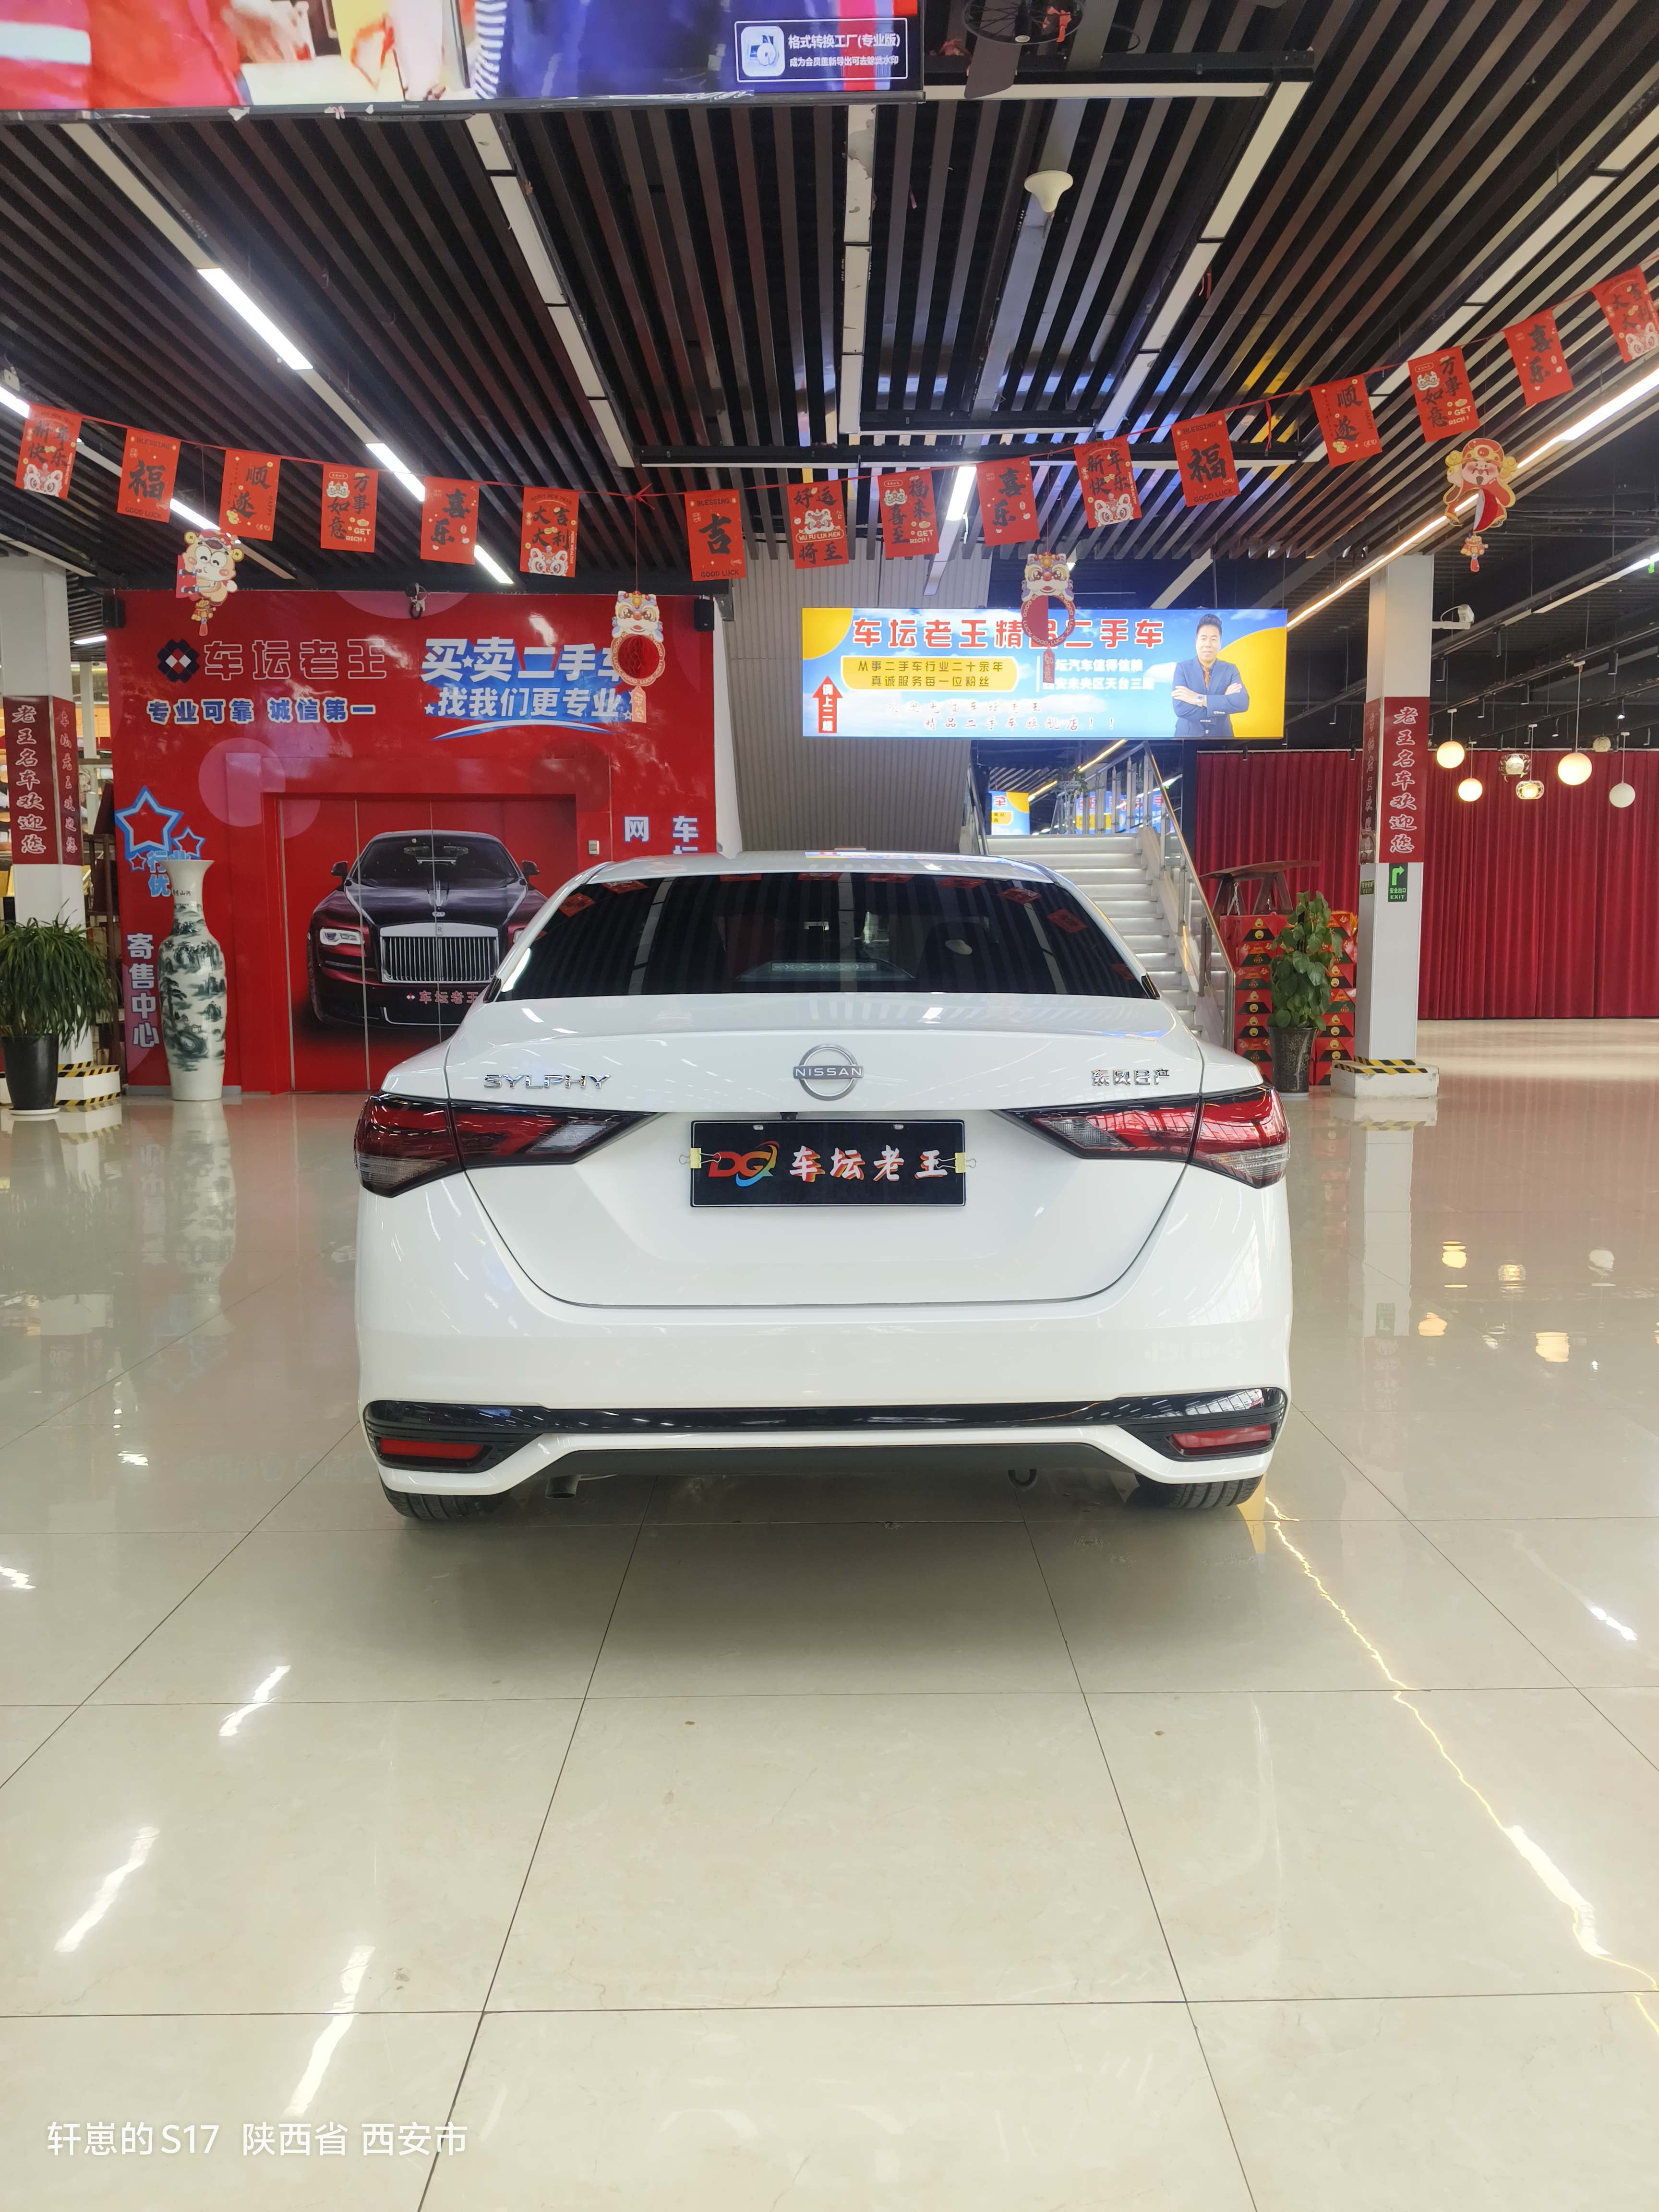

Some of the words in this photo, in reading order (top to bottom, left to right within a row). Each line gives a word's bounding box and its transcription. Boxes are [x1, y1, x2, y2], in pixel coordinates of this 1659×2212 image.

[1454, 406, 1471, 416] GET
[1182, 421, 1216, 434] BLESSING
[137, 437, 170, 449] BLESSING
[1087, 450, 1125, 475] 新年
[1187, 443, 1227, 483] 福
[128, 460, 166, 501] 福
[697, 498, 730, 506] BLESSING
[1194, 493, 1214, 502] GOOD
[1215, 488, 1233, 497] LUCK
[125, 507, 143, 515] GOOD
[145, 510, 162, 519] LUCK
[532, 505, 570, 526] 大吉
[532, 527, 570, 551] 大利
[698, 514, 732, 554] 吉
[204, 639, 386, 681] 车坛老王
[858, 661, 1004, 673] 从事二手车行业二十余年
[1055, 659, 1143, 672] 坛汽车值得信赖
[871, 676, 989, 687] 真诚服务每一位粉丝
[147, 698, 254, 724] 专业可靠
[267, 697, 376, 723] 诚信第一
[438, 687, 621, 717] 找我们更专业
[12, 705, 47, 854] 老王名车欢迎您
[1389, 706, 1419, 854] 老王名车欢迎您
[624, 816, 649, 842] 网
[148, 874, 171, 897] 优
[127, 933, 160, 1048] 寄售中心
[419, 990, 478, 1004] 车坛老王
[483, 1074, 612, 1089] SYLPHY
[795, 1068, 861, 1076] NISSAN
[1091, 1068, 1170, 1086] 东风日产
[790, 1144, 948, 1182] 车坛老王
